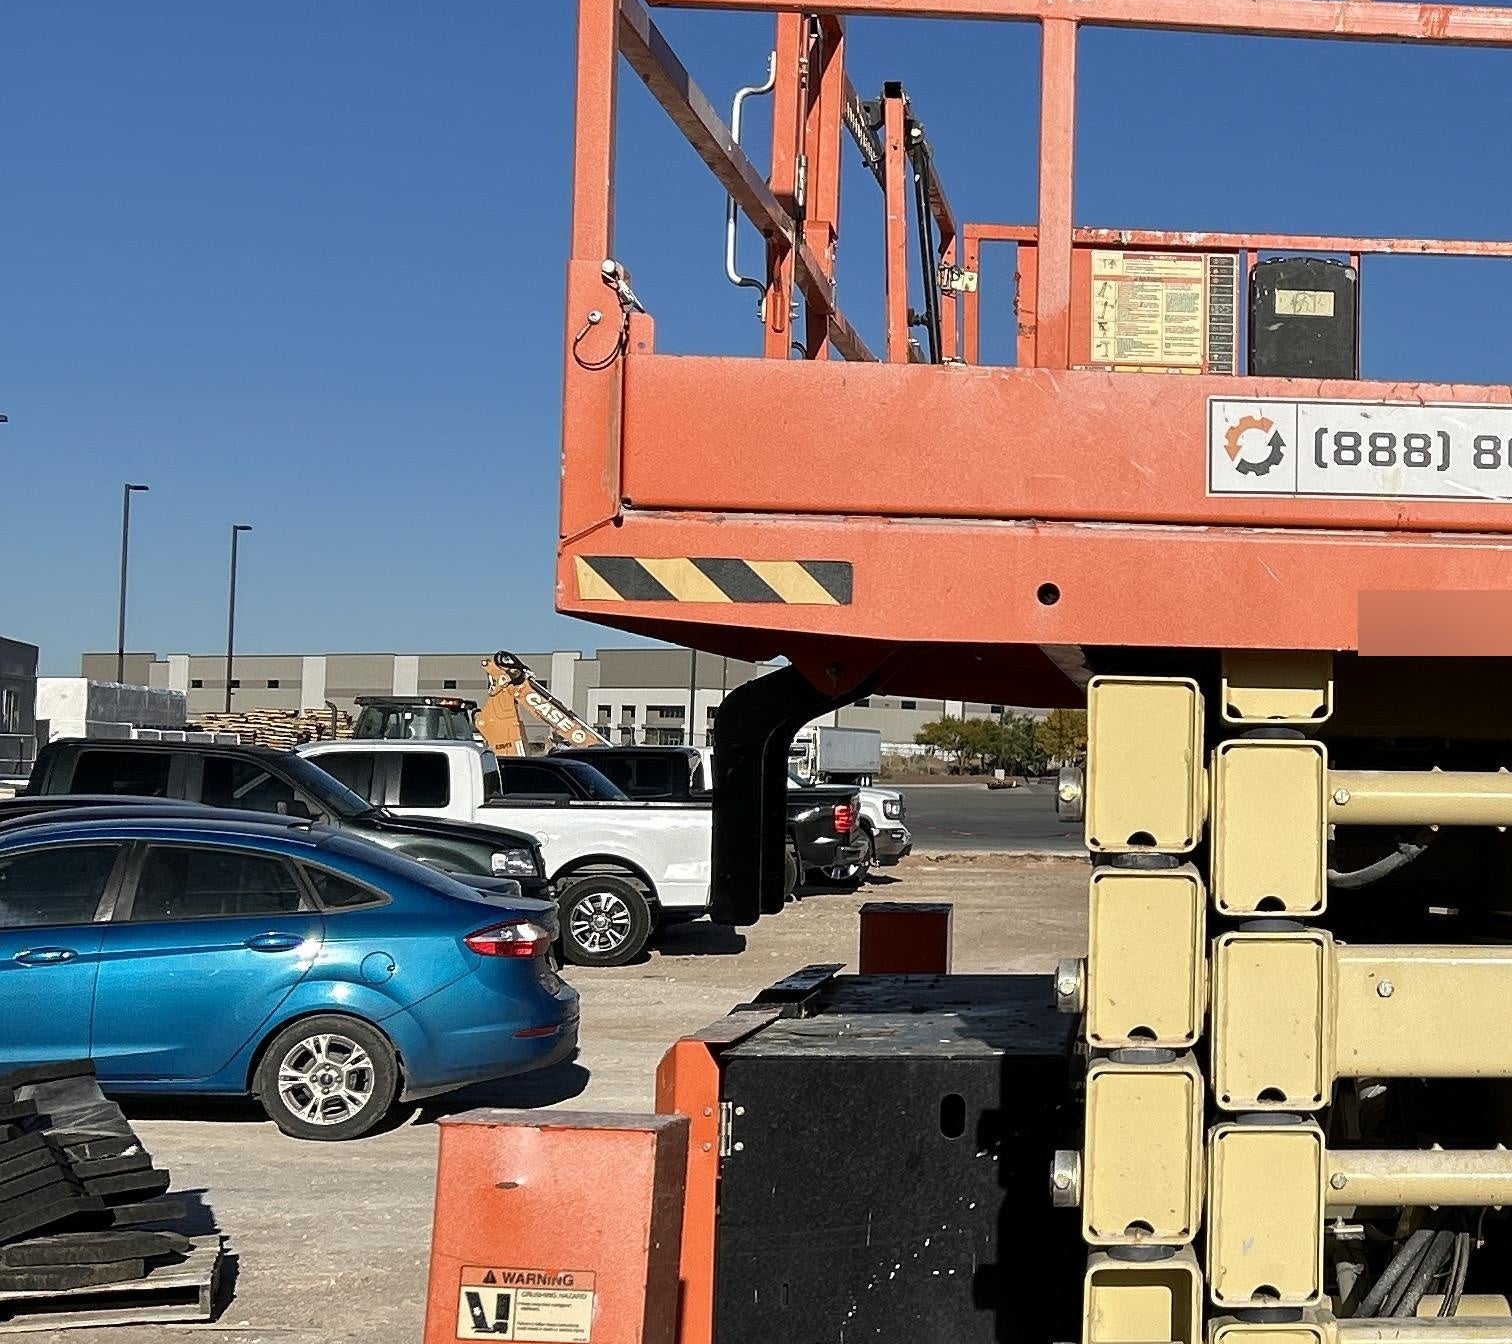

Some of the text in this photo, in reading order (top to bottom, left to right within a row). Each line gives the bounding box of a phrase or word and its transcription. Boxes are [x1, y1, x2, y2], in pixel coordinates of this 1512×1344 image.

[1314, 427, 1451, 472] (888)
[525, 692, 576, 733] CASE
[502, 1271, 574, 1287] WARNING
